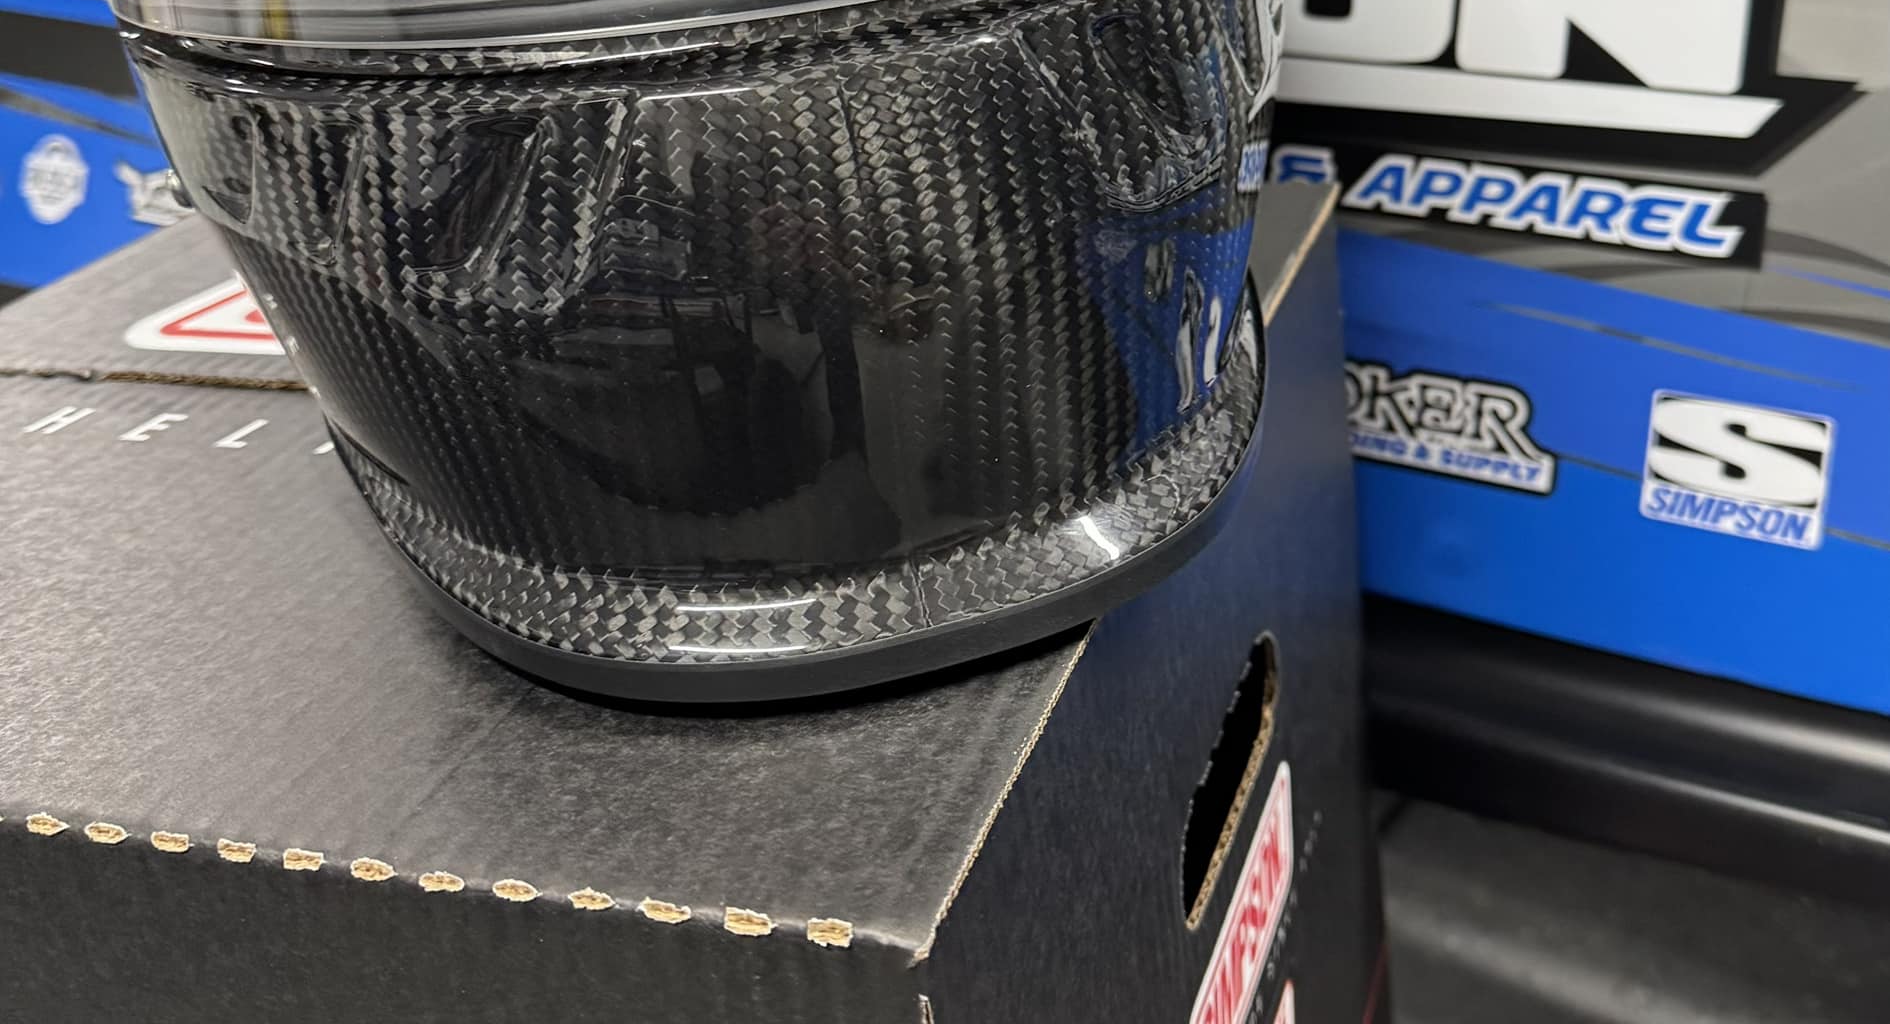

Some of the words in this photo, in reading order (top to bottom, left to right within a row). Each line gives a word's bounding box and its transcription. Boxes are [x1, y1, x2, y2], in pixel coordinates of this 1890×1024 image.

[1345, 156, 1744, 256] APPAREL
[1441, 449, 1541, 483] SUPPLY
[1649, 398, 1827, 508] S
[1648, 487, 1812, 541] SIMPSON
